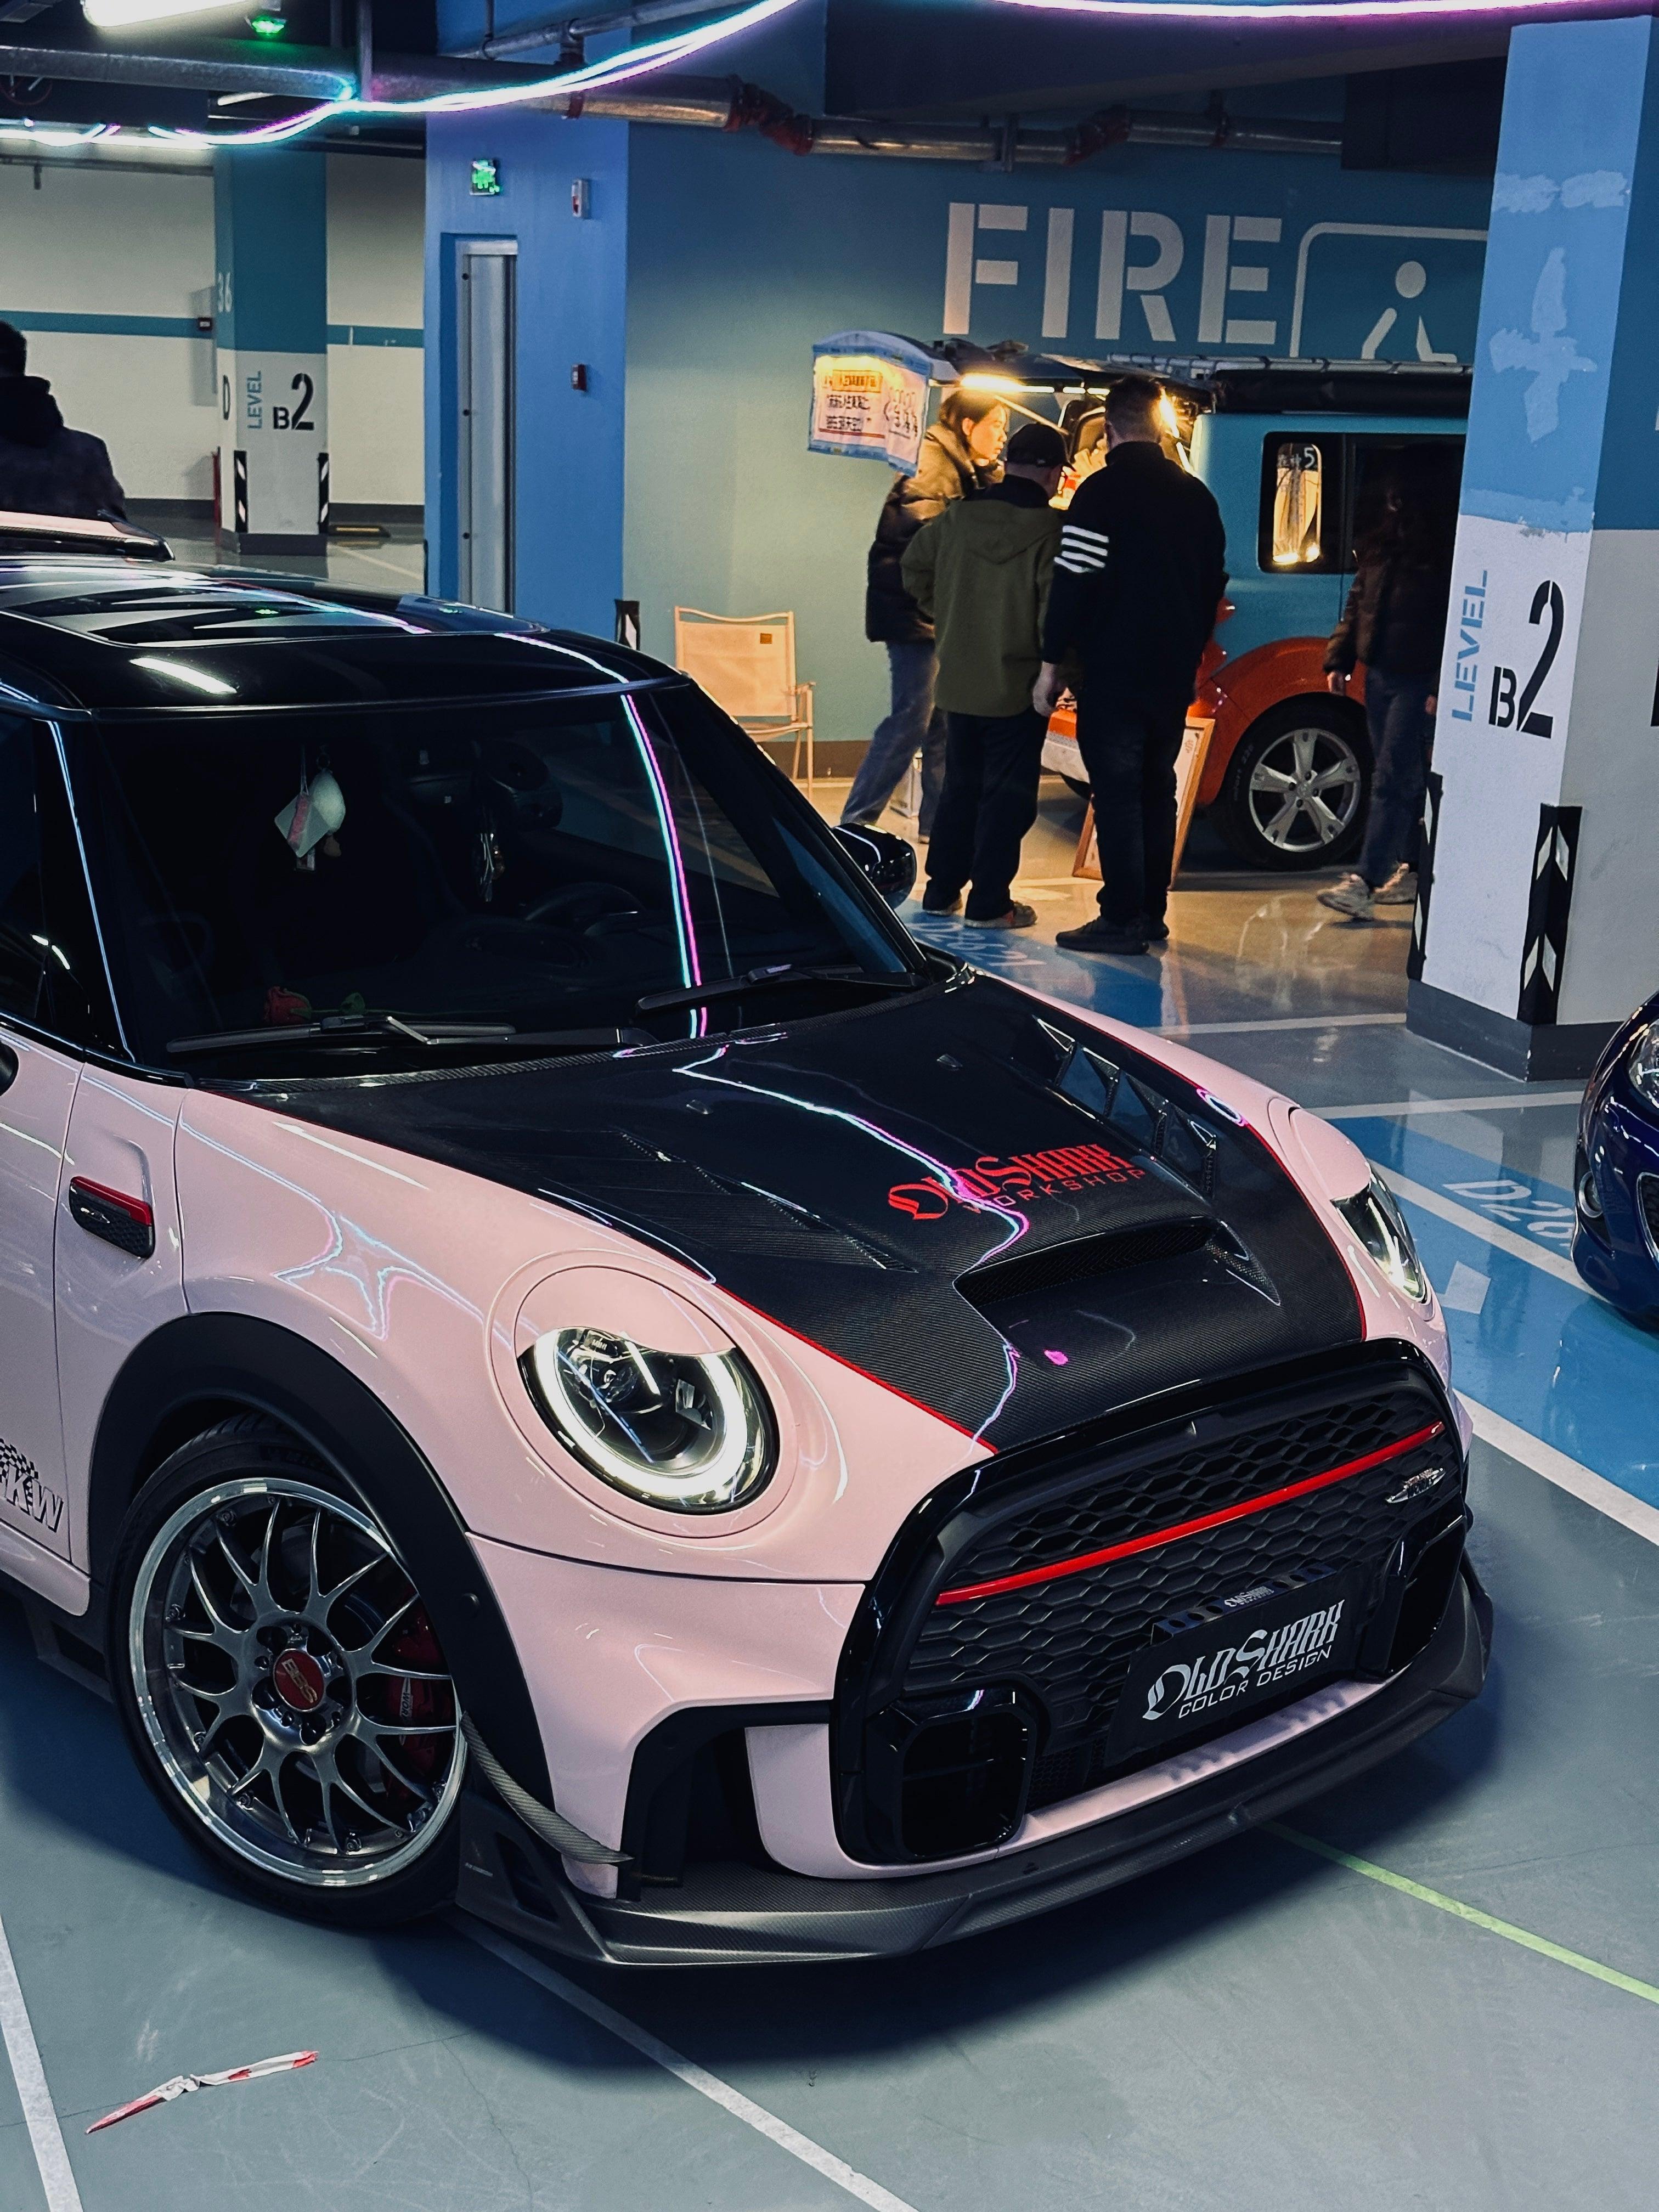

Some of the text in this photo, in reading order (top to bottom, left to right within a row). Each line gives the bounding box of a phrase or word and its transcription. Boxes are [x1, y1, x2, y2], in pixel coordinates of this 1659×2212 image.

[943, 202, 1282, 345] FIRE
[247, 370, 262, 429] LEVEL
[273, 373, 314, 431] B2
[1452, 570, 1488, 722] LEVEL
[1488, 579, 1565, 739] B2
[963, 1169, 1146, 1214] ORKSHOP
[1443, 1180, 1575, 1248] D26
[0, 1463, 64, 1533] KW
[281, 1657, 318, 1703] BBS
[1178, 1645, 1331, 1719] COLOR DESIGN
